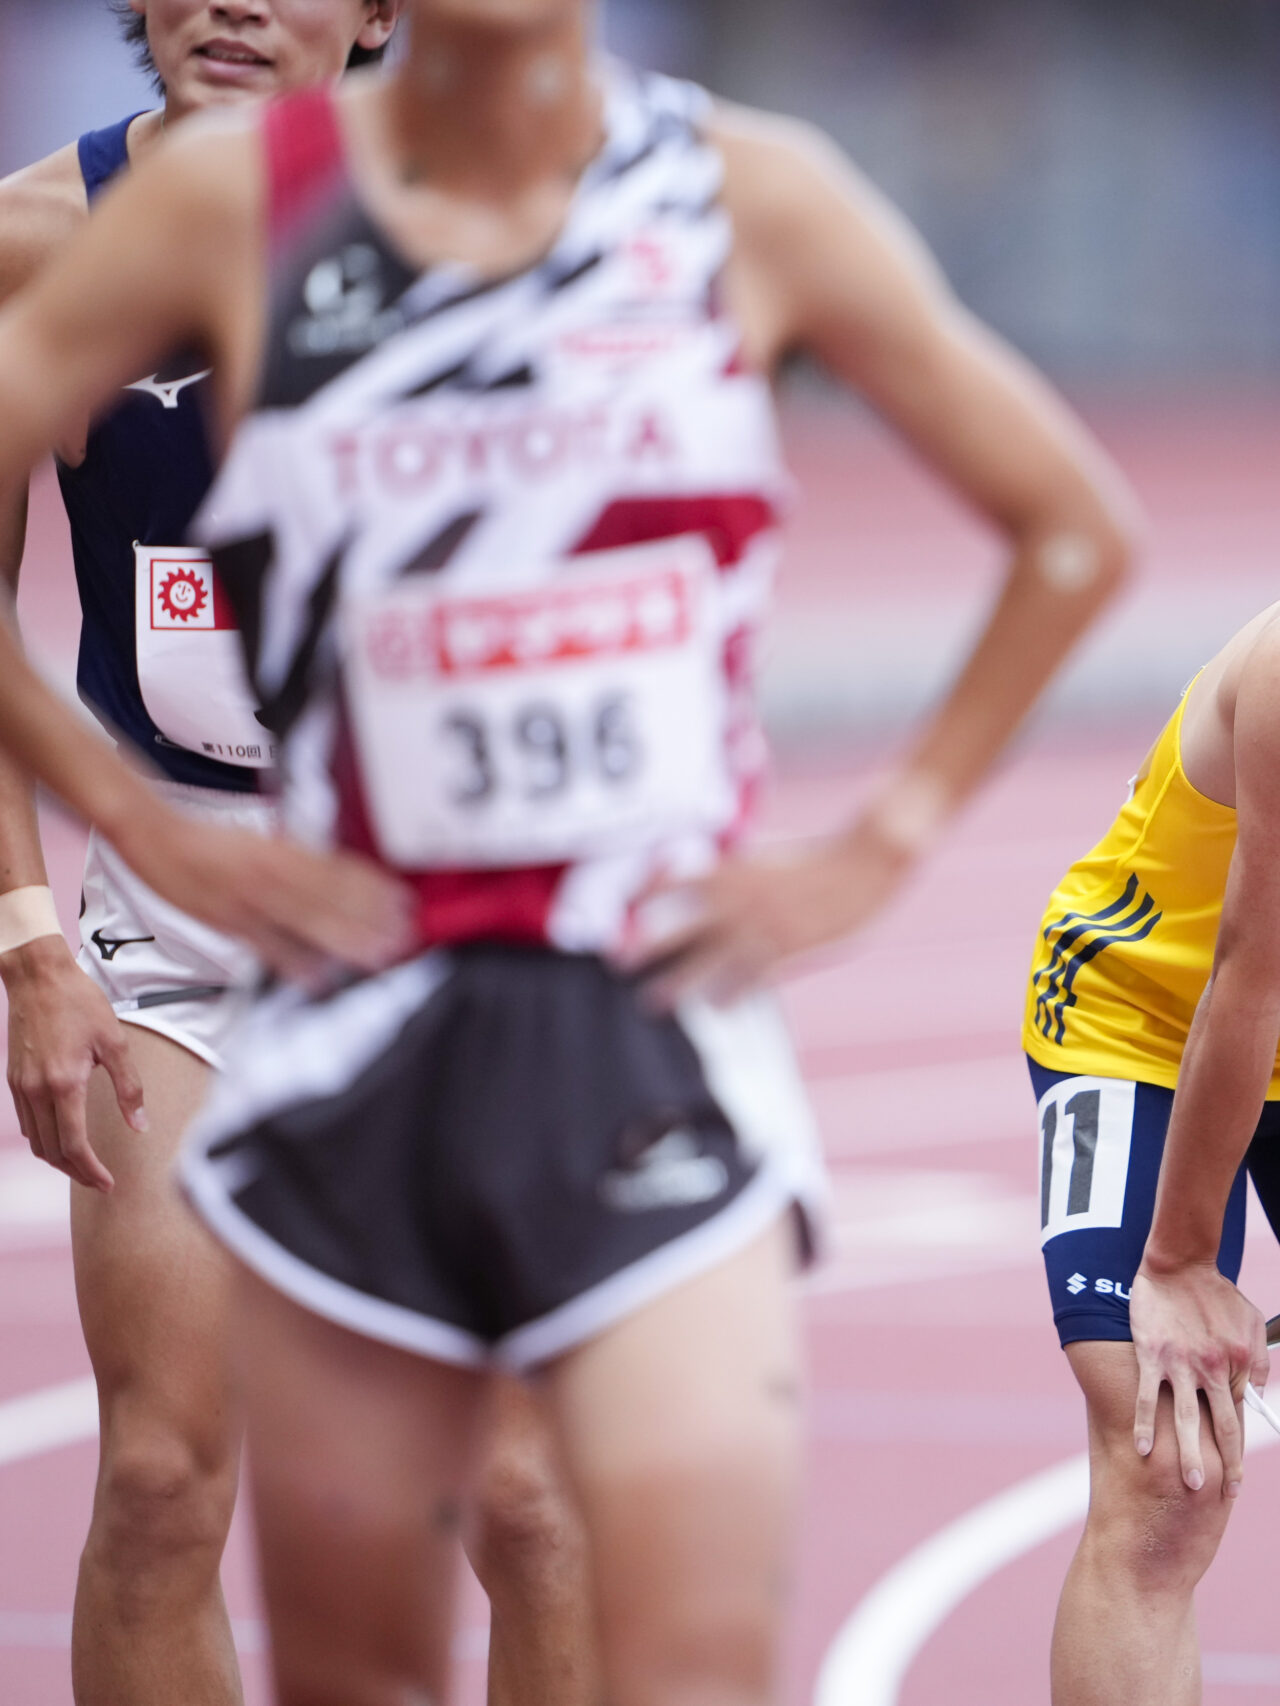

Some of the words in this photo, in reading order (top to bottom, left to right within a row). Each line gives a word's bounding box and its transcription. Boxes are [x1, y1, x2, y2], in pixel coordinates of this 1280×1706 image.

[329, 406, 678, 500] TOYOTA
[440, 692, 642, 812] 396
[1041, 1089, 1101, 1230] 11
[1094, 1278, 1133, 1300] SU
